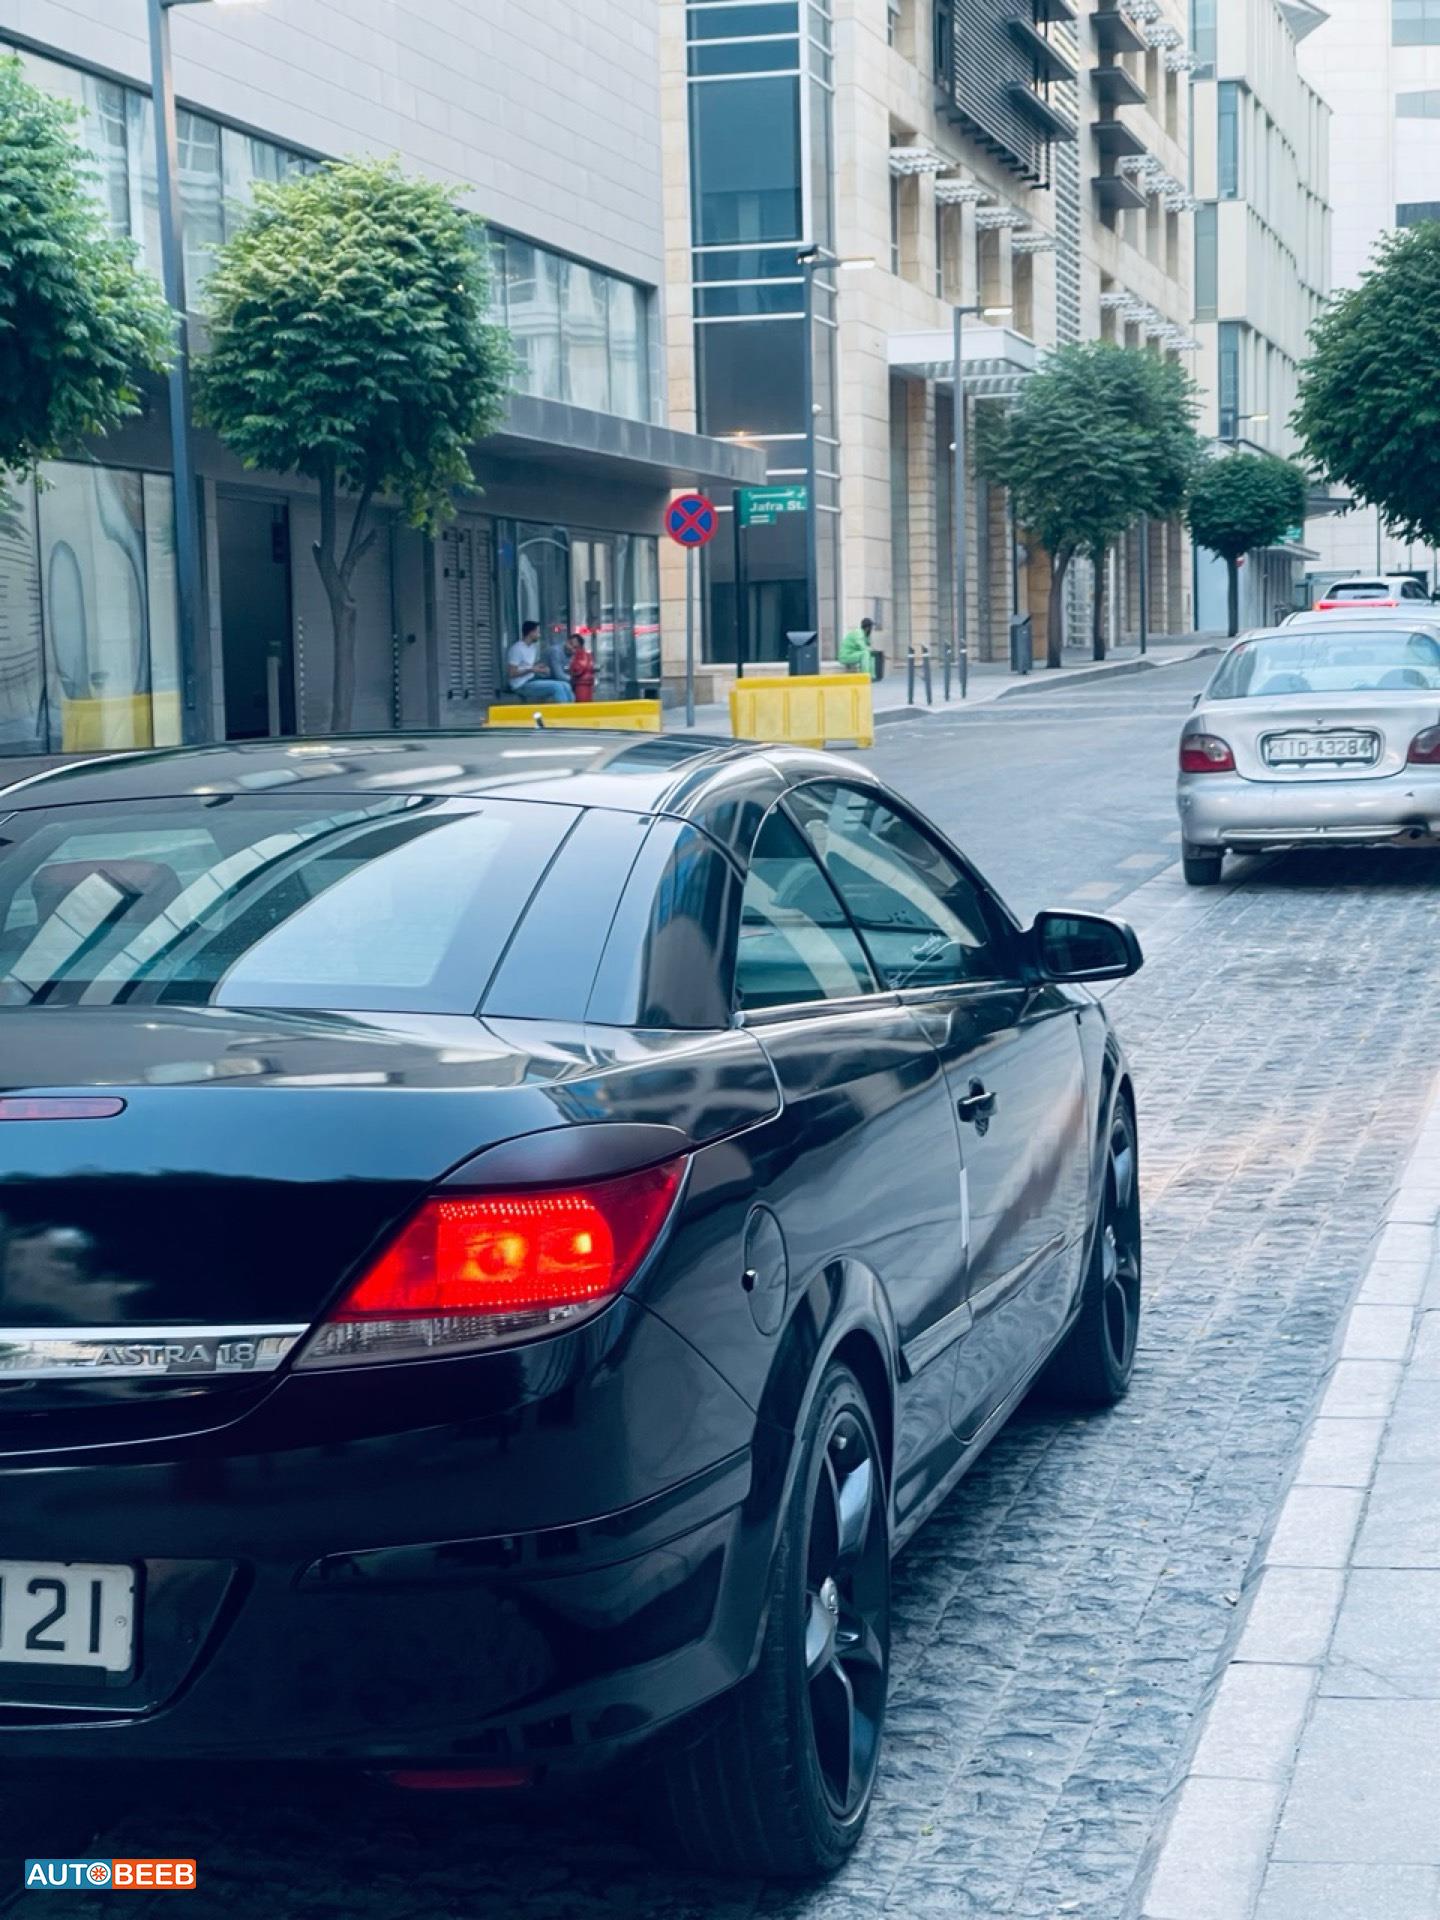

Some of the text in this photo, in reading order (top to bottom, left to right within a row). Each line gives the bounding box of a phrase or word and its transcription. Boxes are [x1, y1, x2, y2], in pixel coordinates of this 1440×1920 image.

[750, 501, 784, 512] Jafra
[95, 1344, 211, 1367] ASTRA
[0, 1577, 102, 1654] 21
